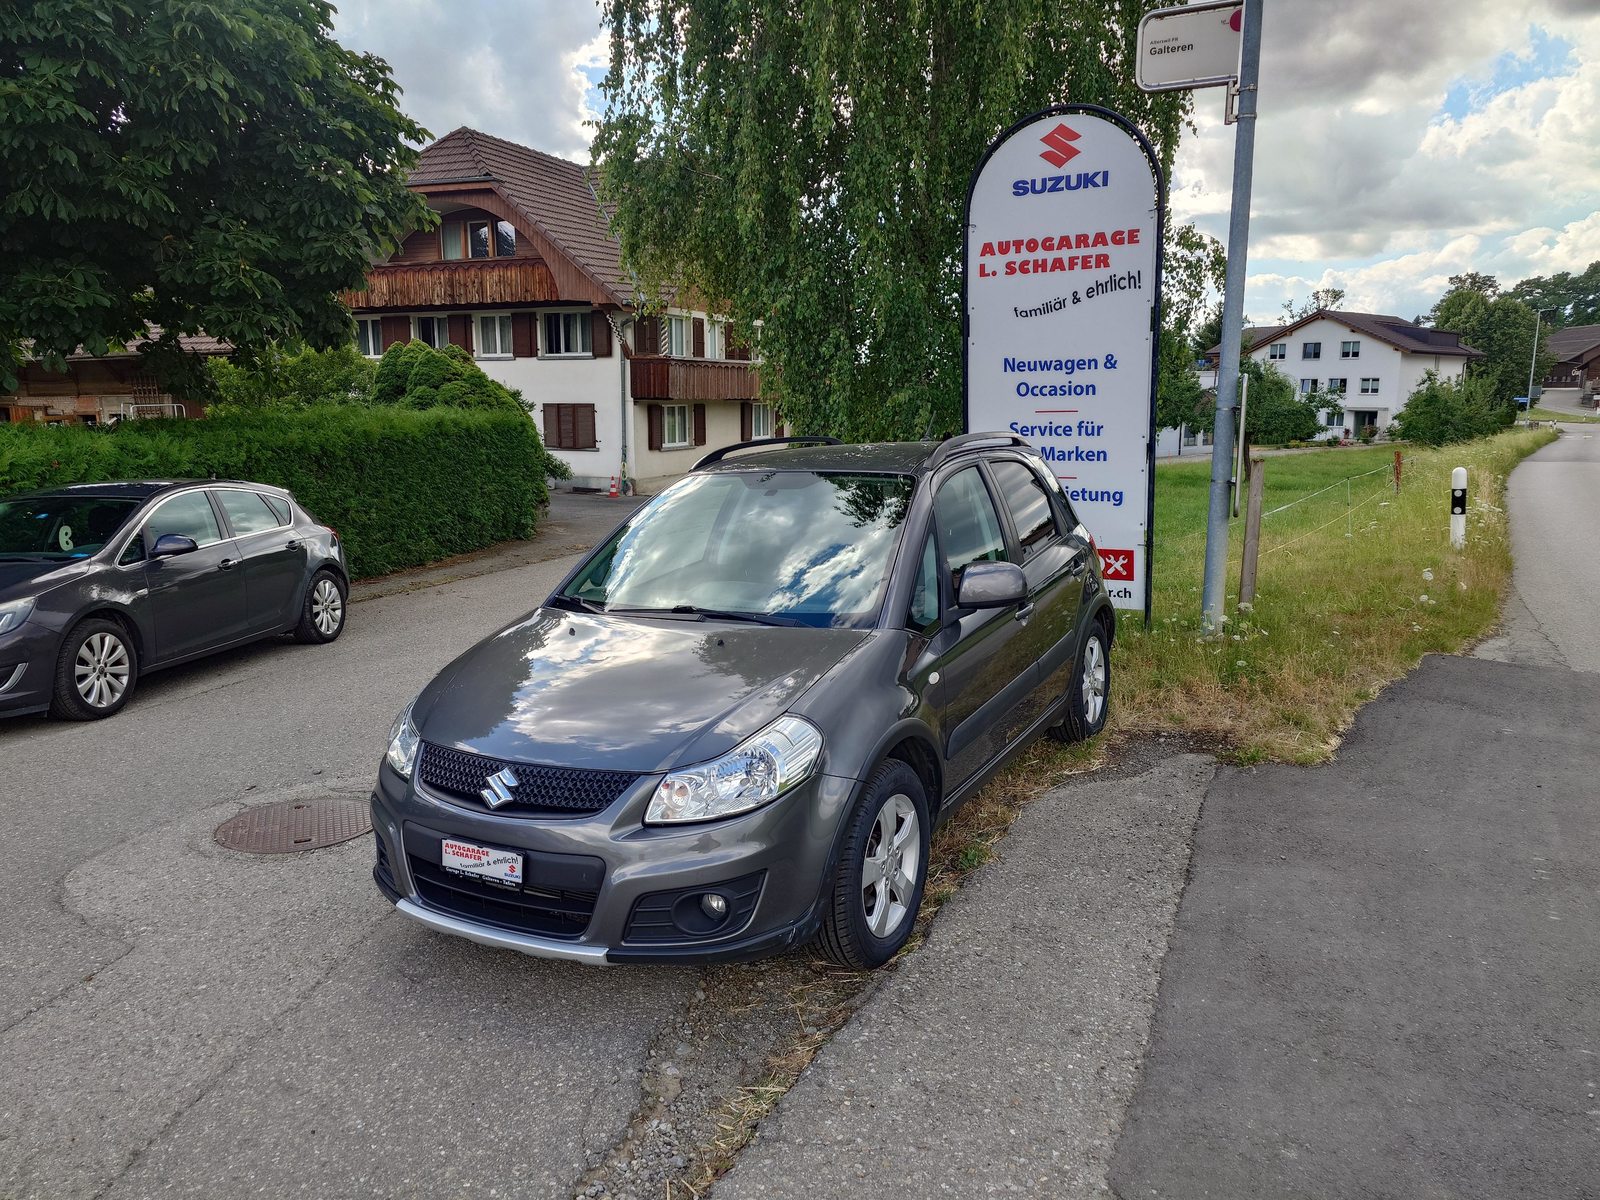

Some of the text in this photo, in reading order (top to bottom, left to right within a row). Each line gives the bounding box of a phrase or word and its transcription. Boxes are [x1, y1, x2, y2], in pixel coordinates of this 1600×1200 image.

[1149, 43, 1194, 56] Galteren
[1012, 170, 1109, 197] SUZUKI
[979, 229, 1141, 256] AUTOGARAGE
[979, 263, 998, 278] L.
[1013, 270, 1143, 319] familiär & ehrlich!
[1003, 353, 1118, 375] Neuwagen &
[1016, 381, 1096, 397] Occasion
[1009, 420, 1104, 437] Service für
[1040, 446, 1108, 461] Marken
[444, 842, 490, 857] AUTOGARAGE
[492, 856, 519, 865] ehrlich!
